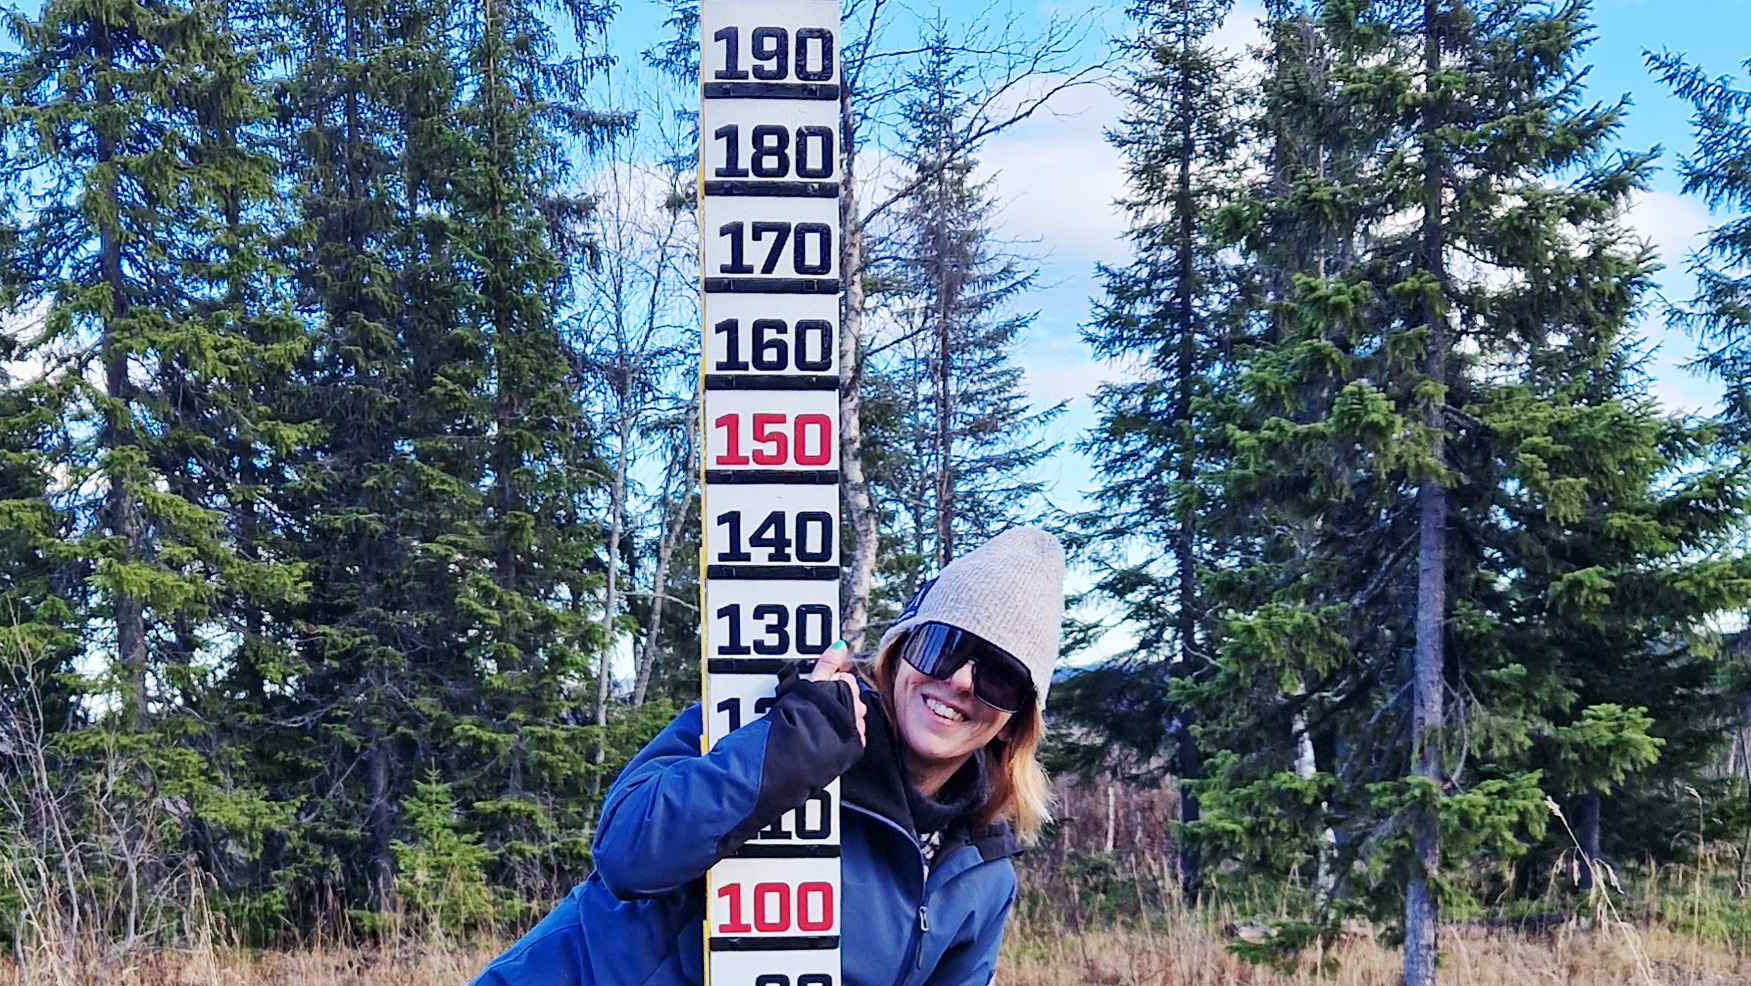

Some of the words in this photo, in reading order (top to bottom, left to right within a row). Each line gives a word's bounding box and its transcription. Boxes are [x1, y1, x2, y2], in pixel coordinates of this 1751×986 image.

[714, 26, 834, 82] 190
[714, 124, 834, 179] 180
[719, 220, 834, 276] 170
[714, 317, 834, 372] 160
[714, 413, 834, 466] 150
[717, 510, 834, 563] 140
[717, 603, 834, 656] 130
[717, 881, 834, 934] 100
